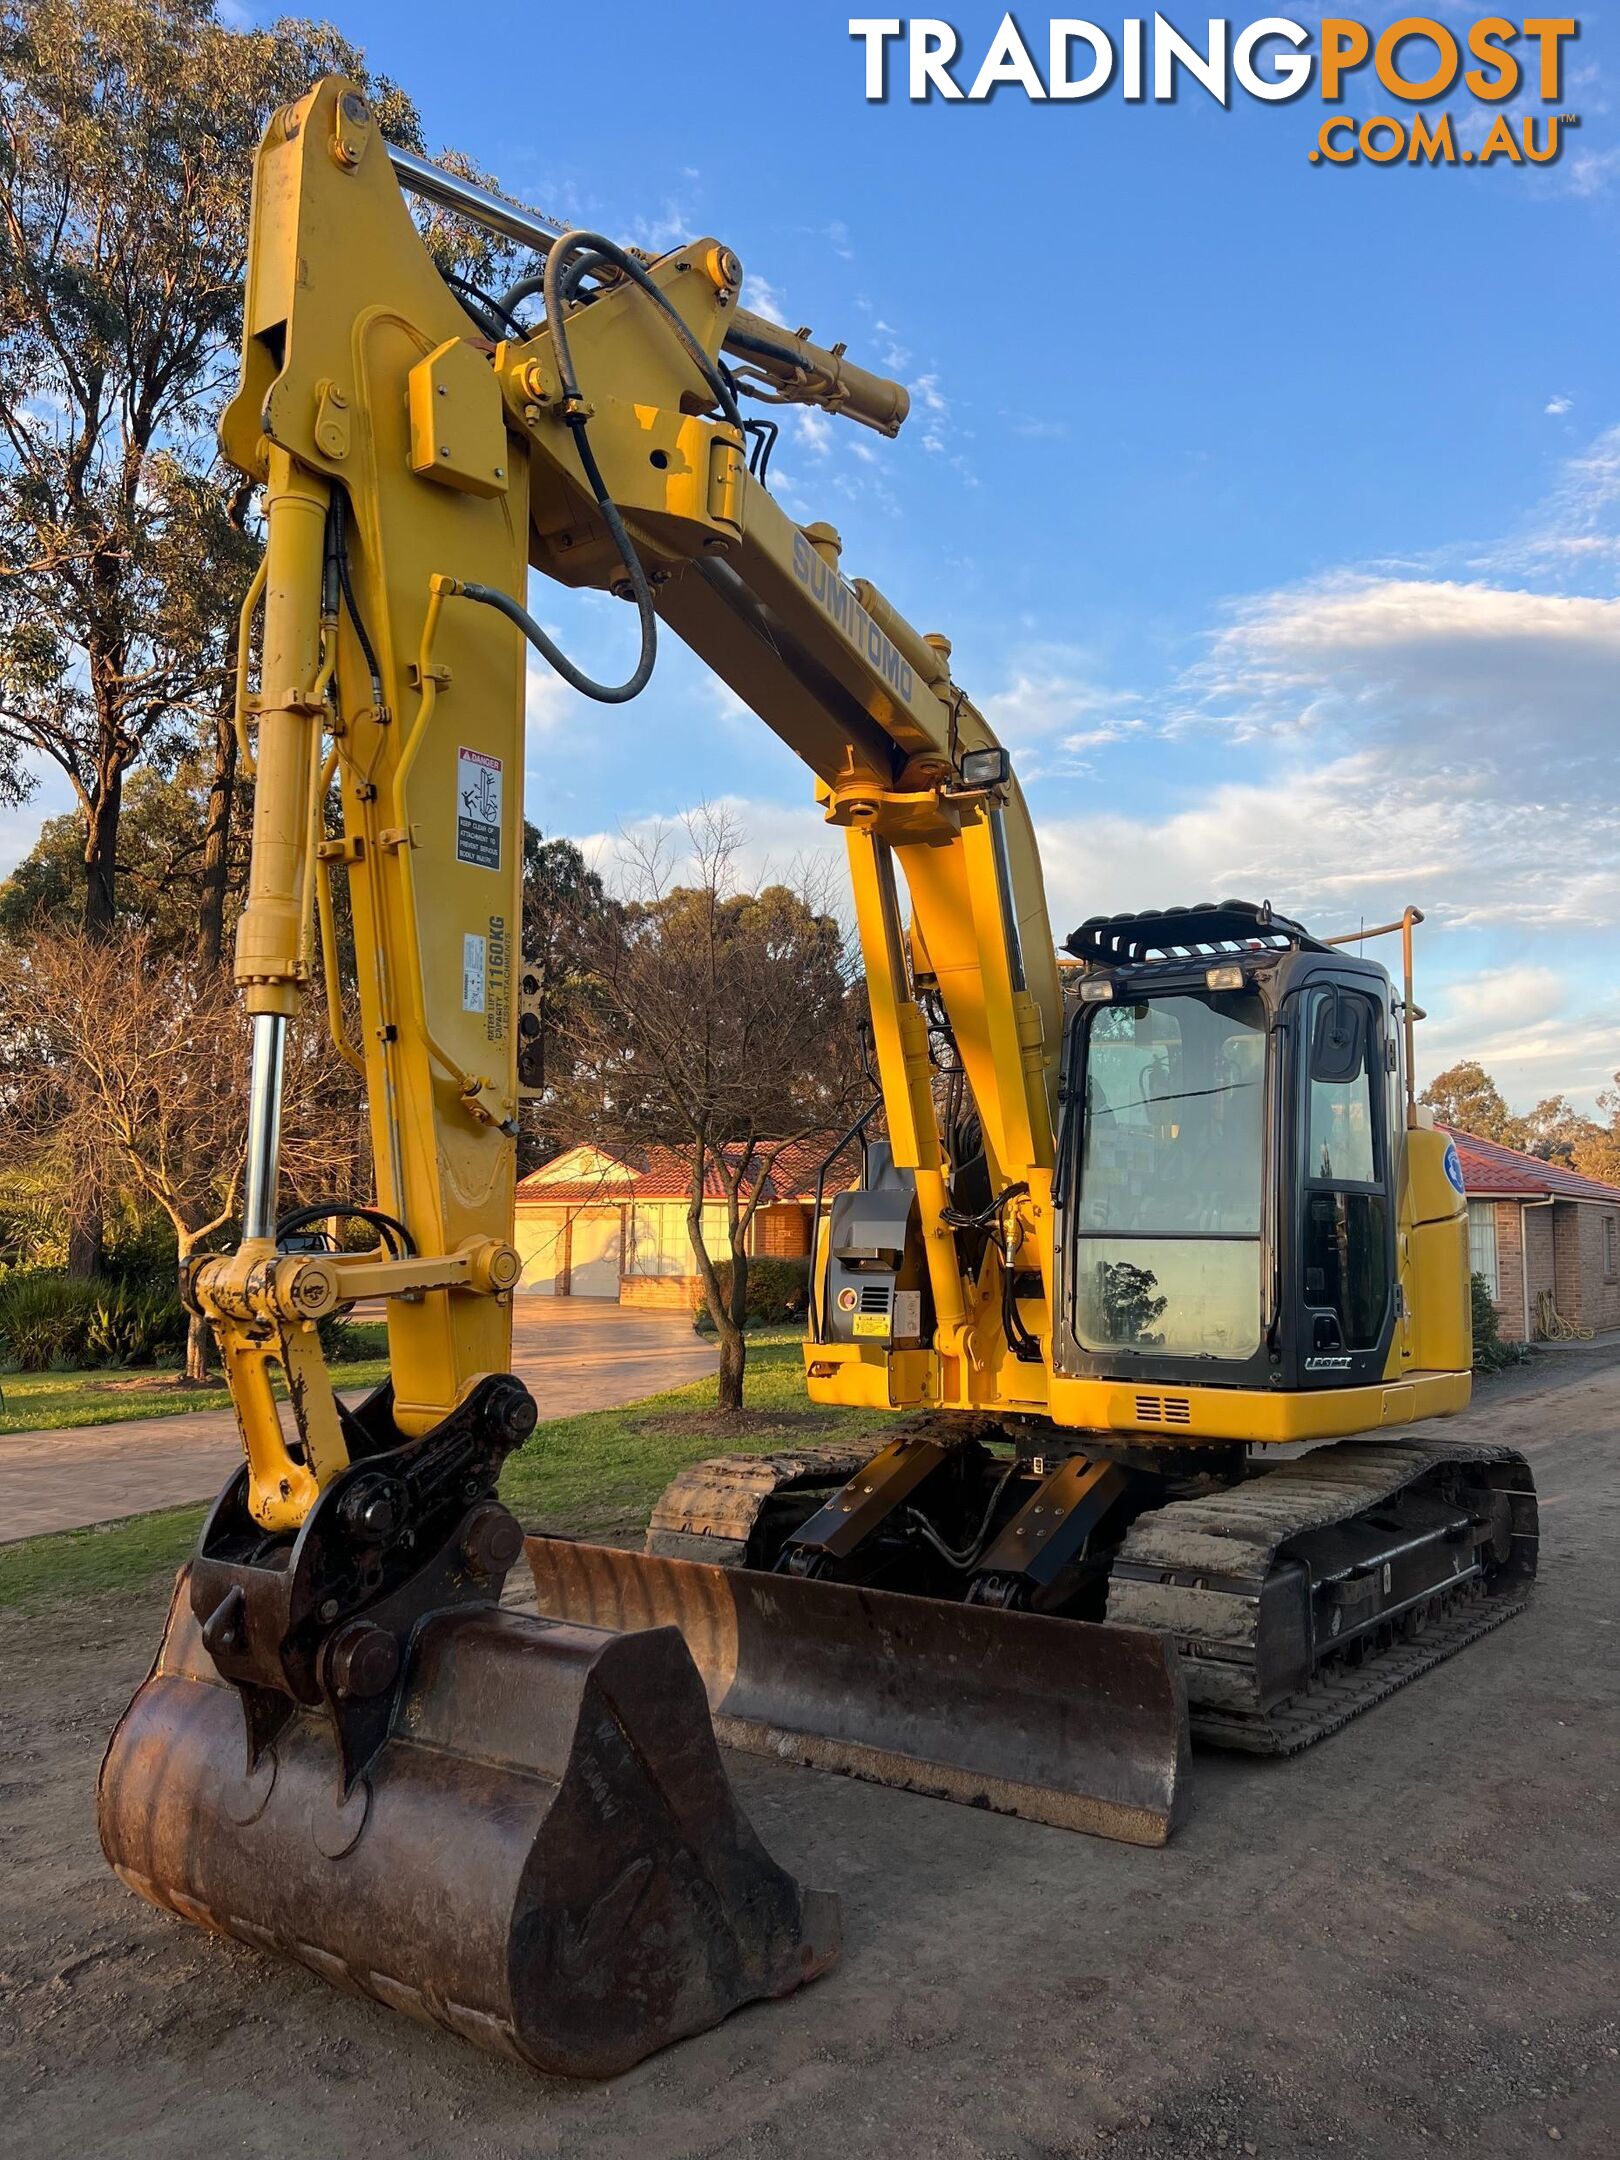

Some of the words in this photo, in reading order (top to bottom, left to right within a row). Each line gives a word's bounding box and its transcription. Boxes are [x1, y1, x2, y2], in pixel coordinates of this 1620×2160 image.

[793, 532, 912, 703] SUMITOMO
[471, 752, 499, 769] DANGER
[460, 819, 471, 828] KEEP
[472, 822, 486, 832] CLEAR
[460, 829, 489, 843] ATTACHMENT
[459, 839, 479, 850] PREVENT
[479, 845, 498, 856] SERIOUS
[459, 849, 476, 859] BODILY
[503, 933, 511, 1003] ATTACHMENTS
[487, 990, 495, 1011] LIFT
[487, 1013, 495, 1041] RATED
[495, 997, 503, 1039] CAPACITY
